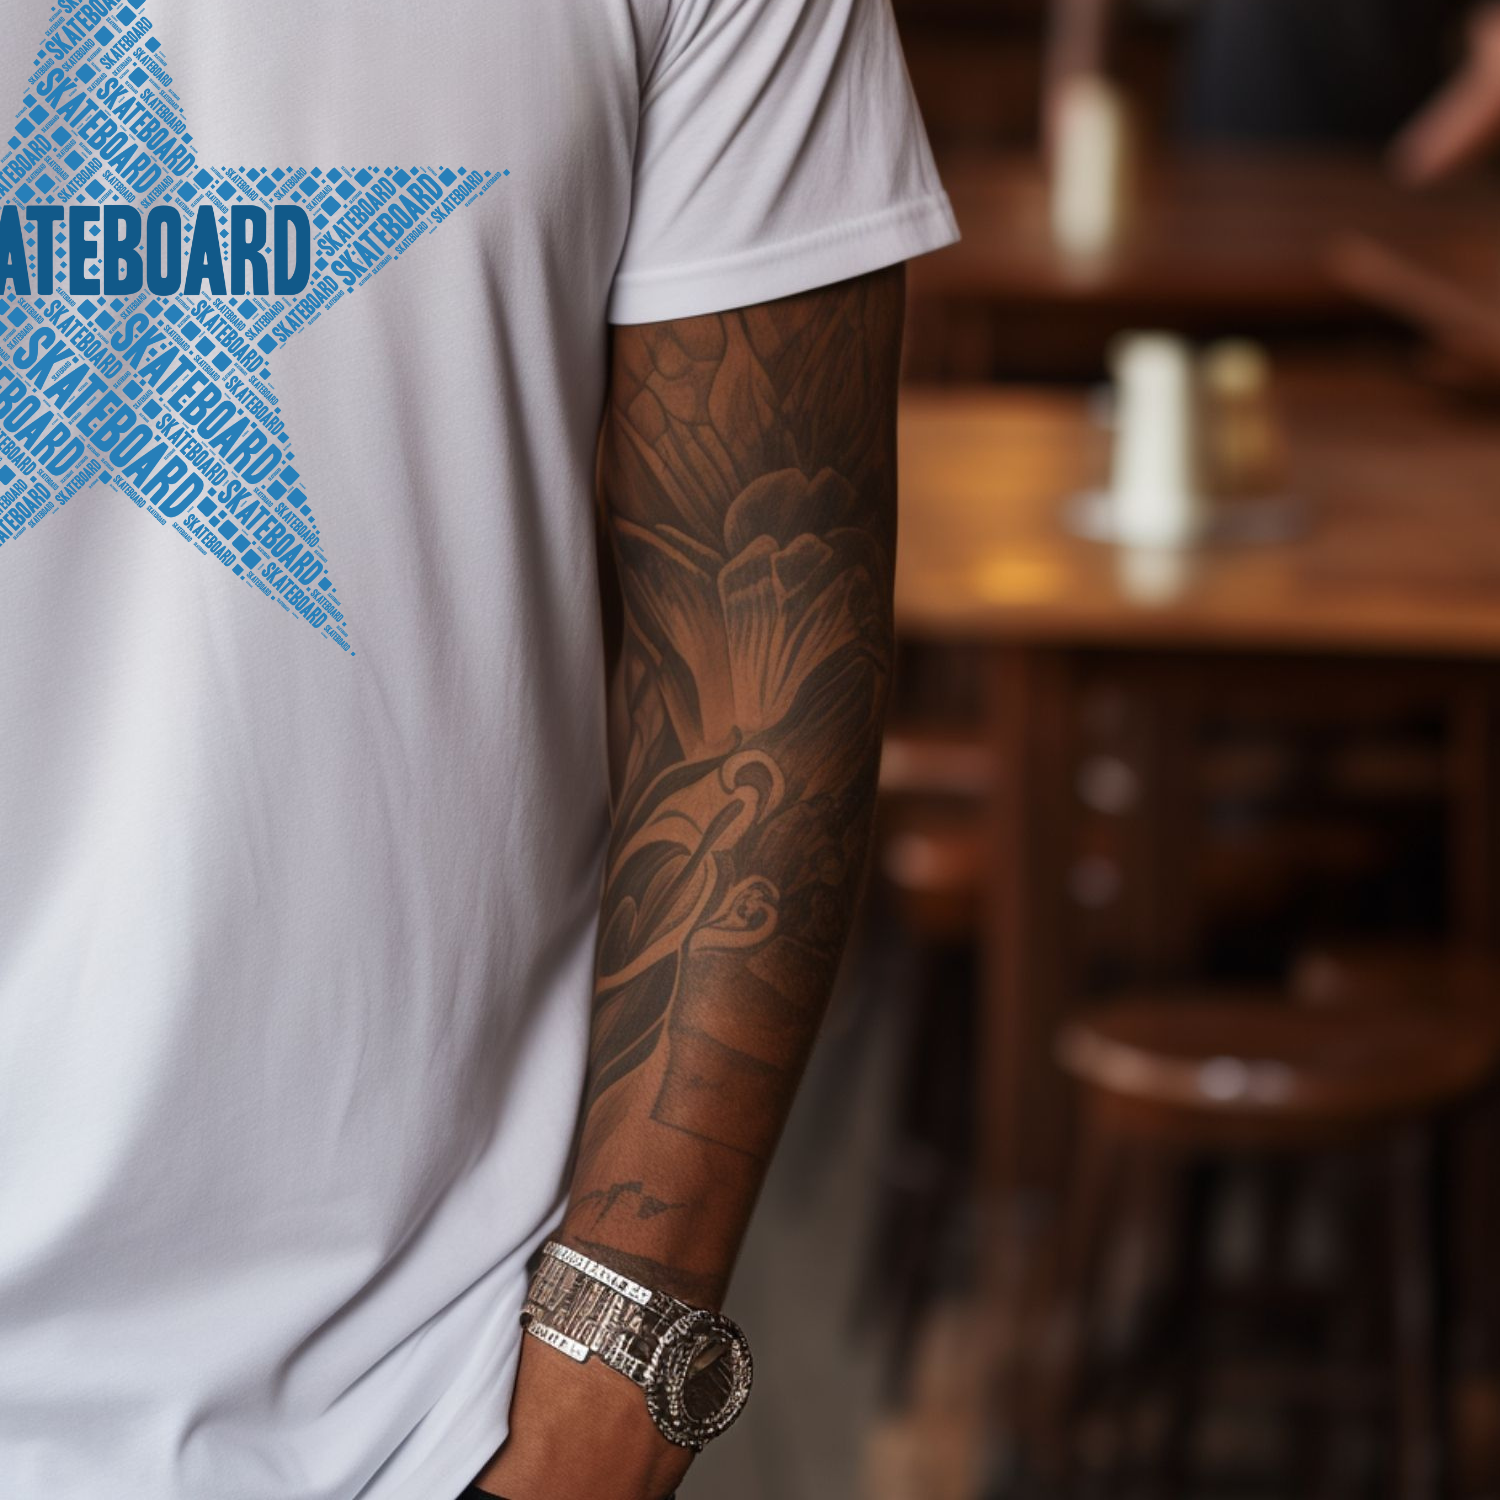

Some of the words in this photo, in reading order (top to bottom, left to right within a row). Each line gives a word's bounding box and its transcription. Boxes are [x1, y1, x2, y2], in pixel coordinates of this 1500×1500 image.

[62, 39, 95, 72] SKATEBOARD
[100, 17, 152, 70] SKATEBOARD
[133, 47, 172, 87] SKATEBOARD
[36, 68, 161, 193] SKATEBOARD
[96, 78, 195, 176] SKATEBOARD
[140, 88, 186, 134] SKATEBOARD
[58, 158, 102, 202] SKATEBOARD
[102, 170, 135, 203] SKATEBOARD
[140, 176, 174, 208] SKATEBOARD
[226, 168, 258, 201] SKATEBOARD
[274, 167, 307, 200] SKATEBOARD
[431, 170, 483, 223] SKATEBOARD
[317, 177, 396, 256] SKATEBOARD
[331, 174, 443, 286] SKATEBOARD
[395, 221, 428, 254] SKATEBOARD
[213, 298, 246, 331] SKATEBOARD
[245, 301, 284, 340] SKATEBOARD
[272, 276, 338, 342] SKATEBOARD
[44, 300, 123, 379] SKATEBOARD
[191, 300, 264, 372] SKATEBOARD
[13, 327, 204, 518] SKATEBOARD
[111, 313, 282, 484] SKATEBOARD
[225, 376, 284, 435] SKATEBOARD
[156, 413, 228, 486] SKATEBOARD
[55, 459, 101, 505] SKATEBOARD
[113, 475, 146, 508] SKATEBOARD
[183, 514, 236, 566] SKATEBOARD
[218, 480, 323, 585] SKATEBOARD
[274, 502, 319, 547] SKATEBOARD
[262, 562, 327, 628] SKATEBOARD
[310, 589, 344, 622] SKATEBOARD
